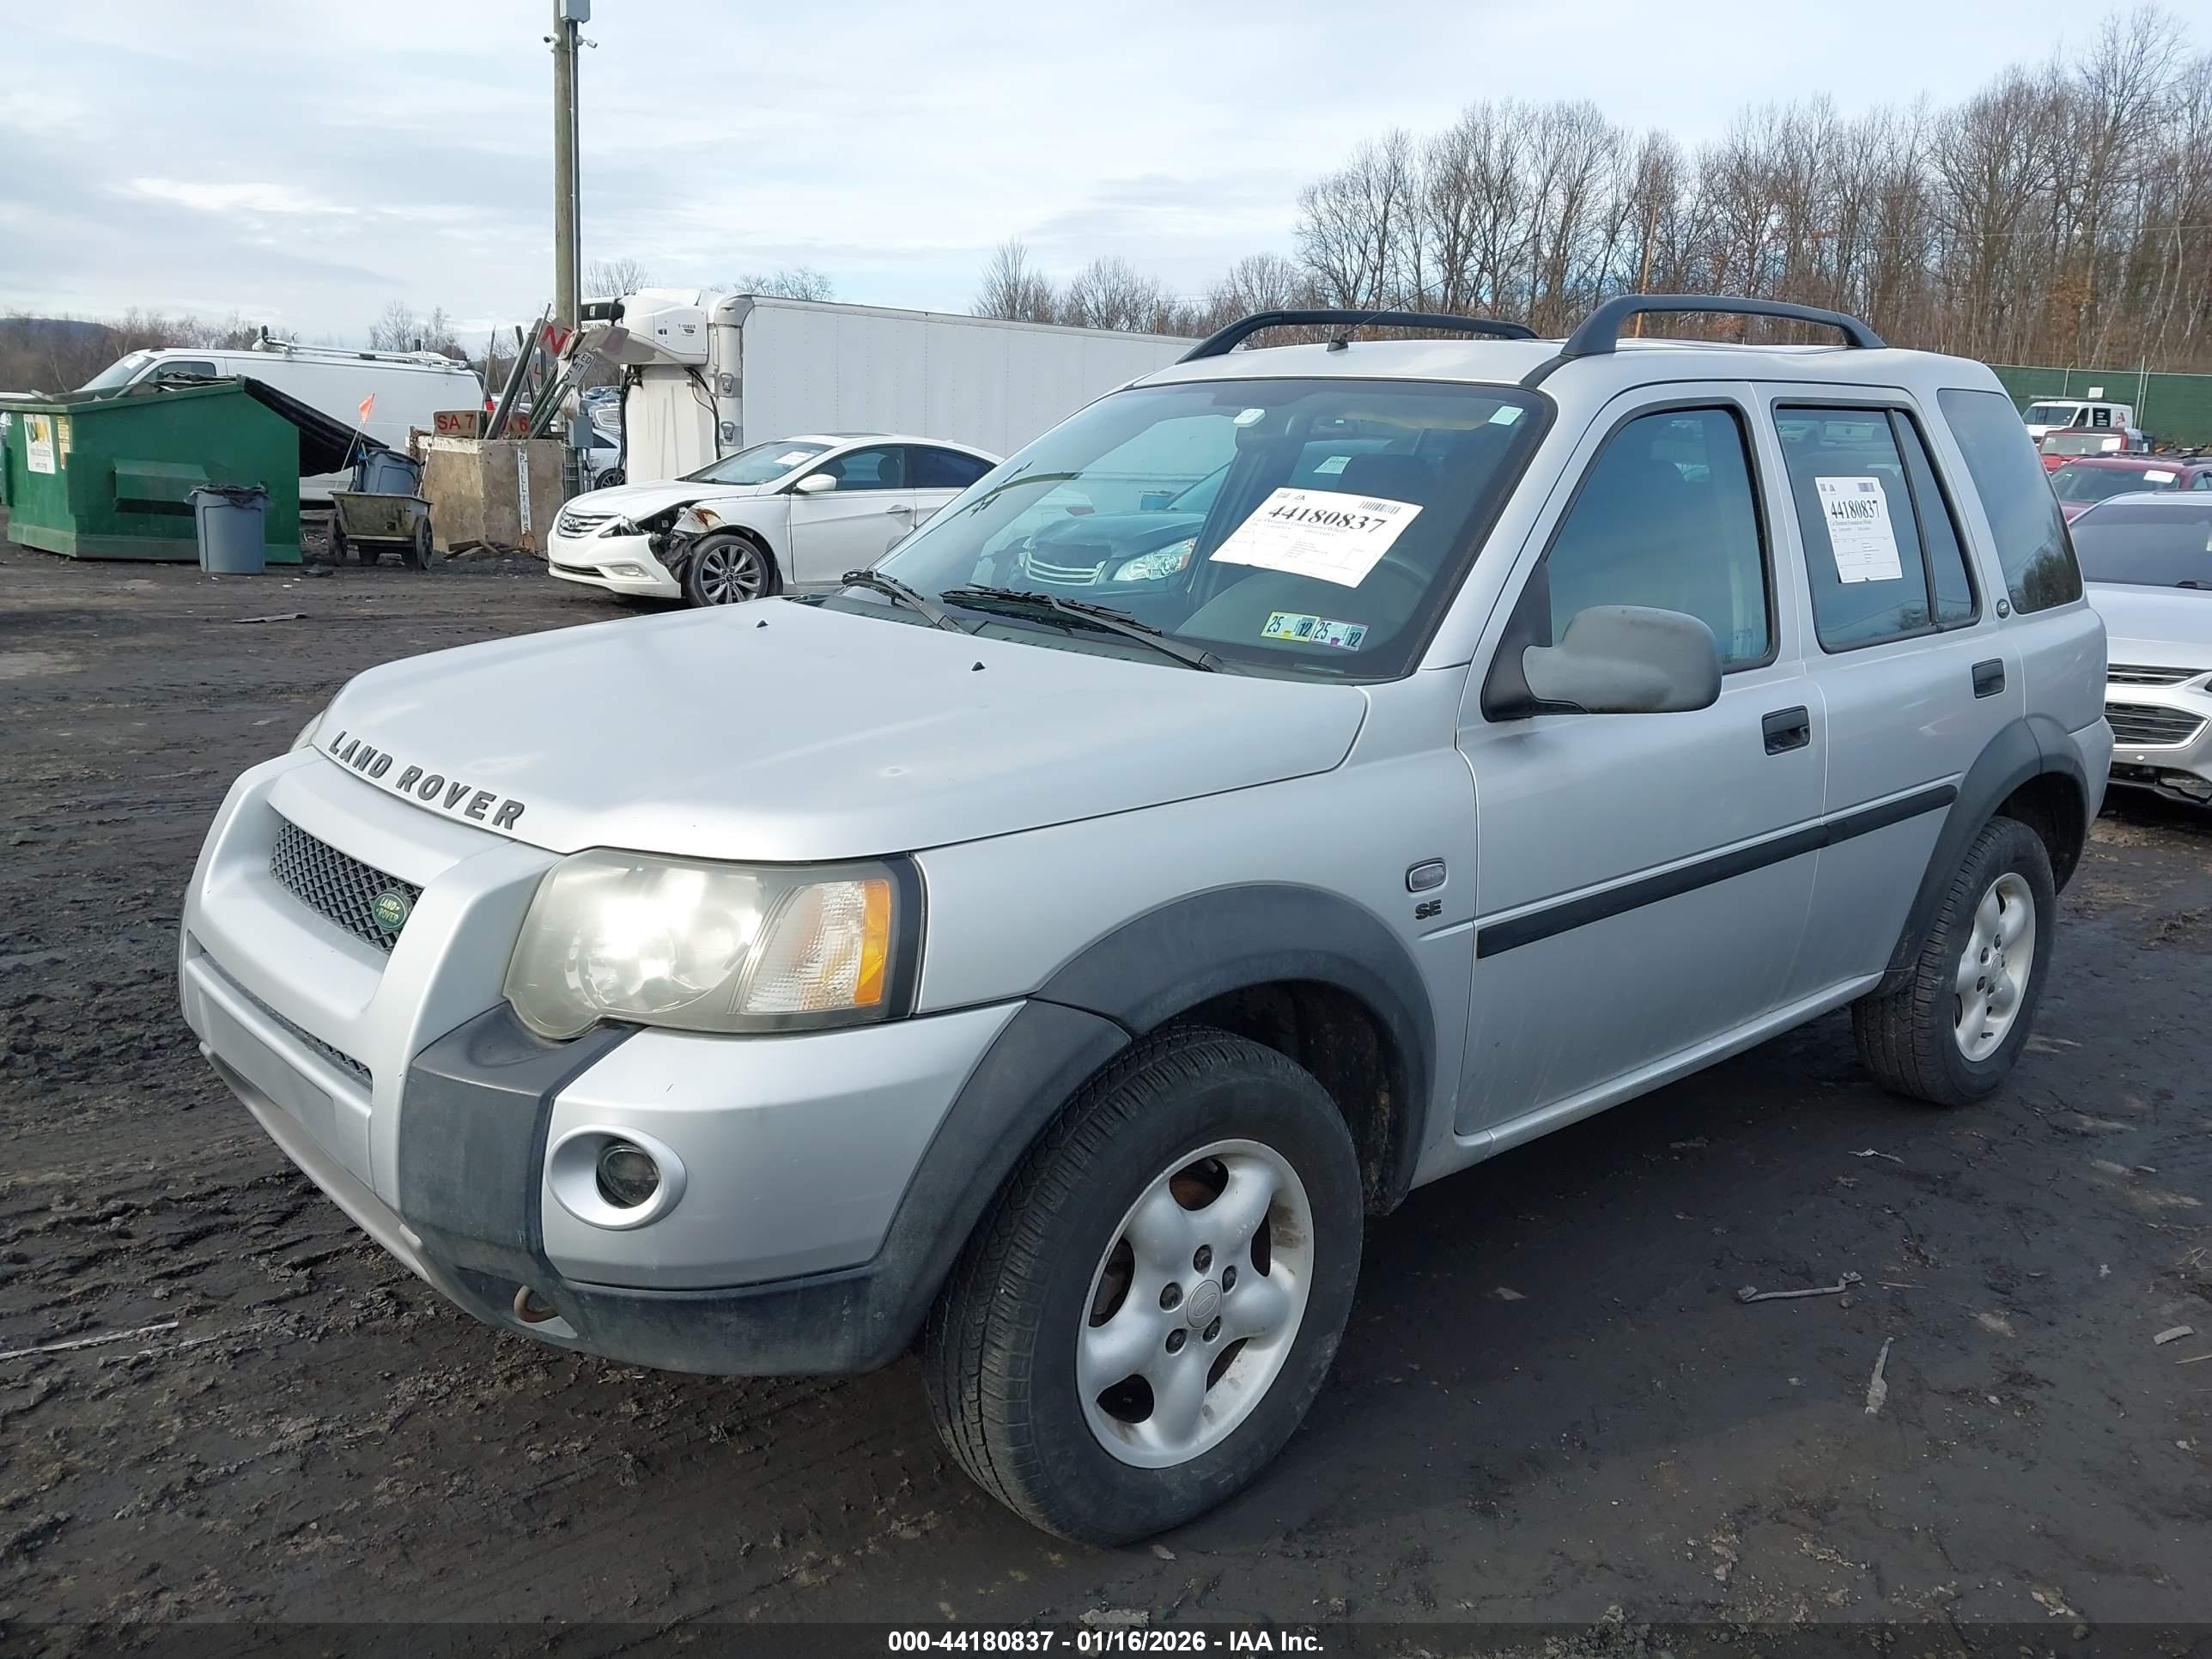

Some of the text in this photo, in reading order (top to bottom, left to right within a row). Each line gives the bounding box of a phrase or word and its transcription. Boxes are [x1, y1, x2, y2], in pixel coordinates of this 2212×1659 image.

[437, 413, 475, 430] SA 7
[1268, 504, 1388, 533] 44180837
[1831, 499, 1880, 520] 44180837
[1267, 615, 1285, 633] 25
[1297, 622, 1313, 637] 12
[1314, 622, 1332, 640] 25
[1346, 631, 1362, 647] 12
[328, 730, 525, 830] LAND ROVER
[1414, 899, 1443, 921] SE
